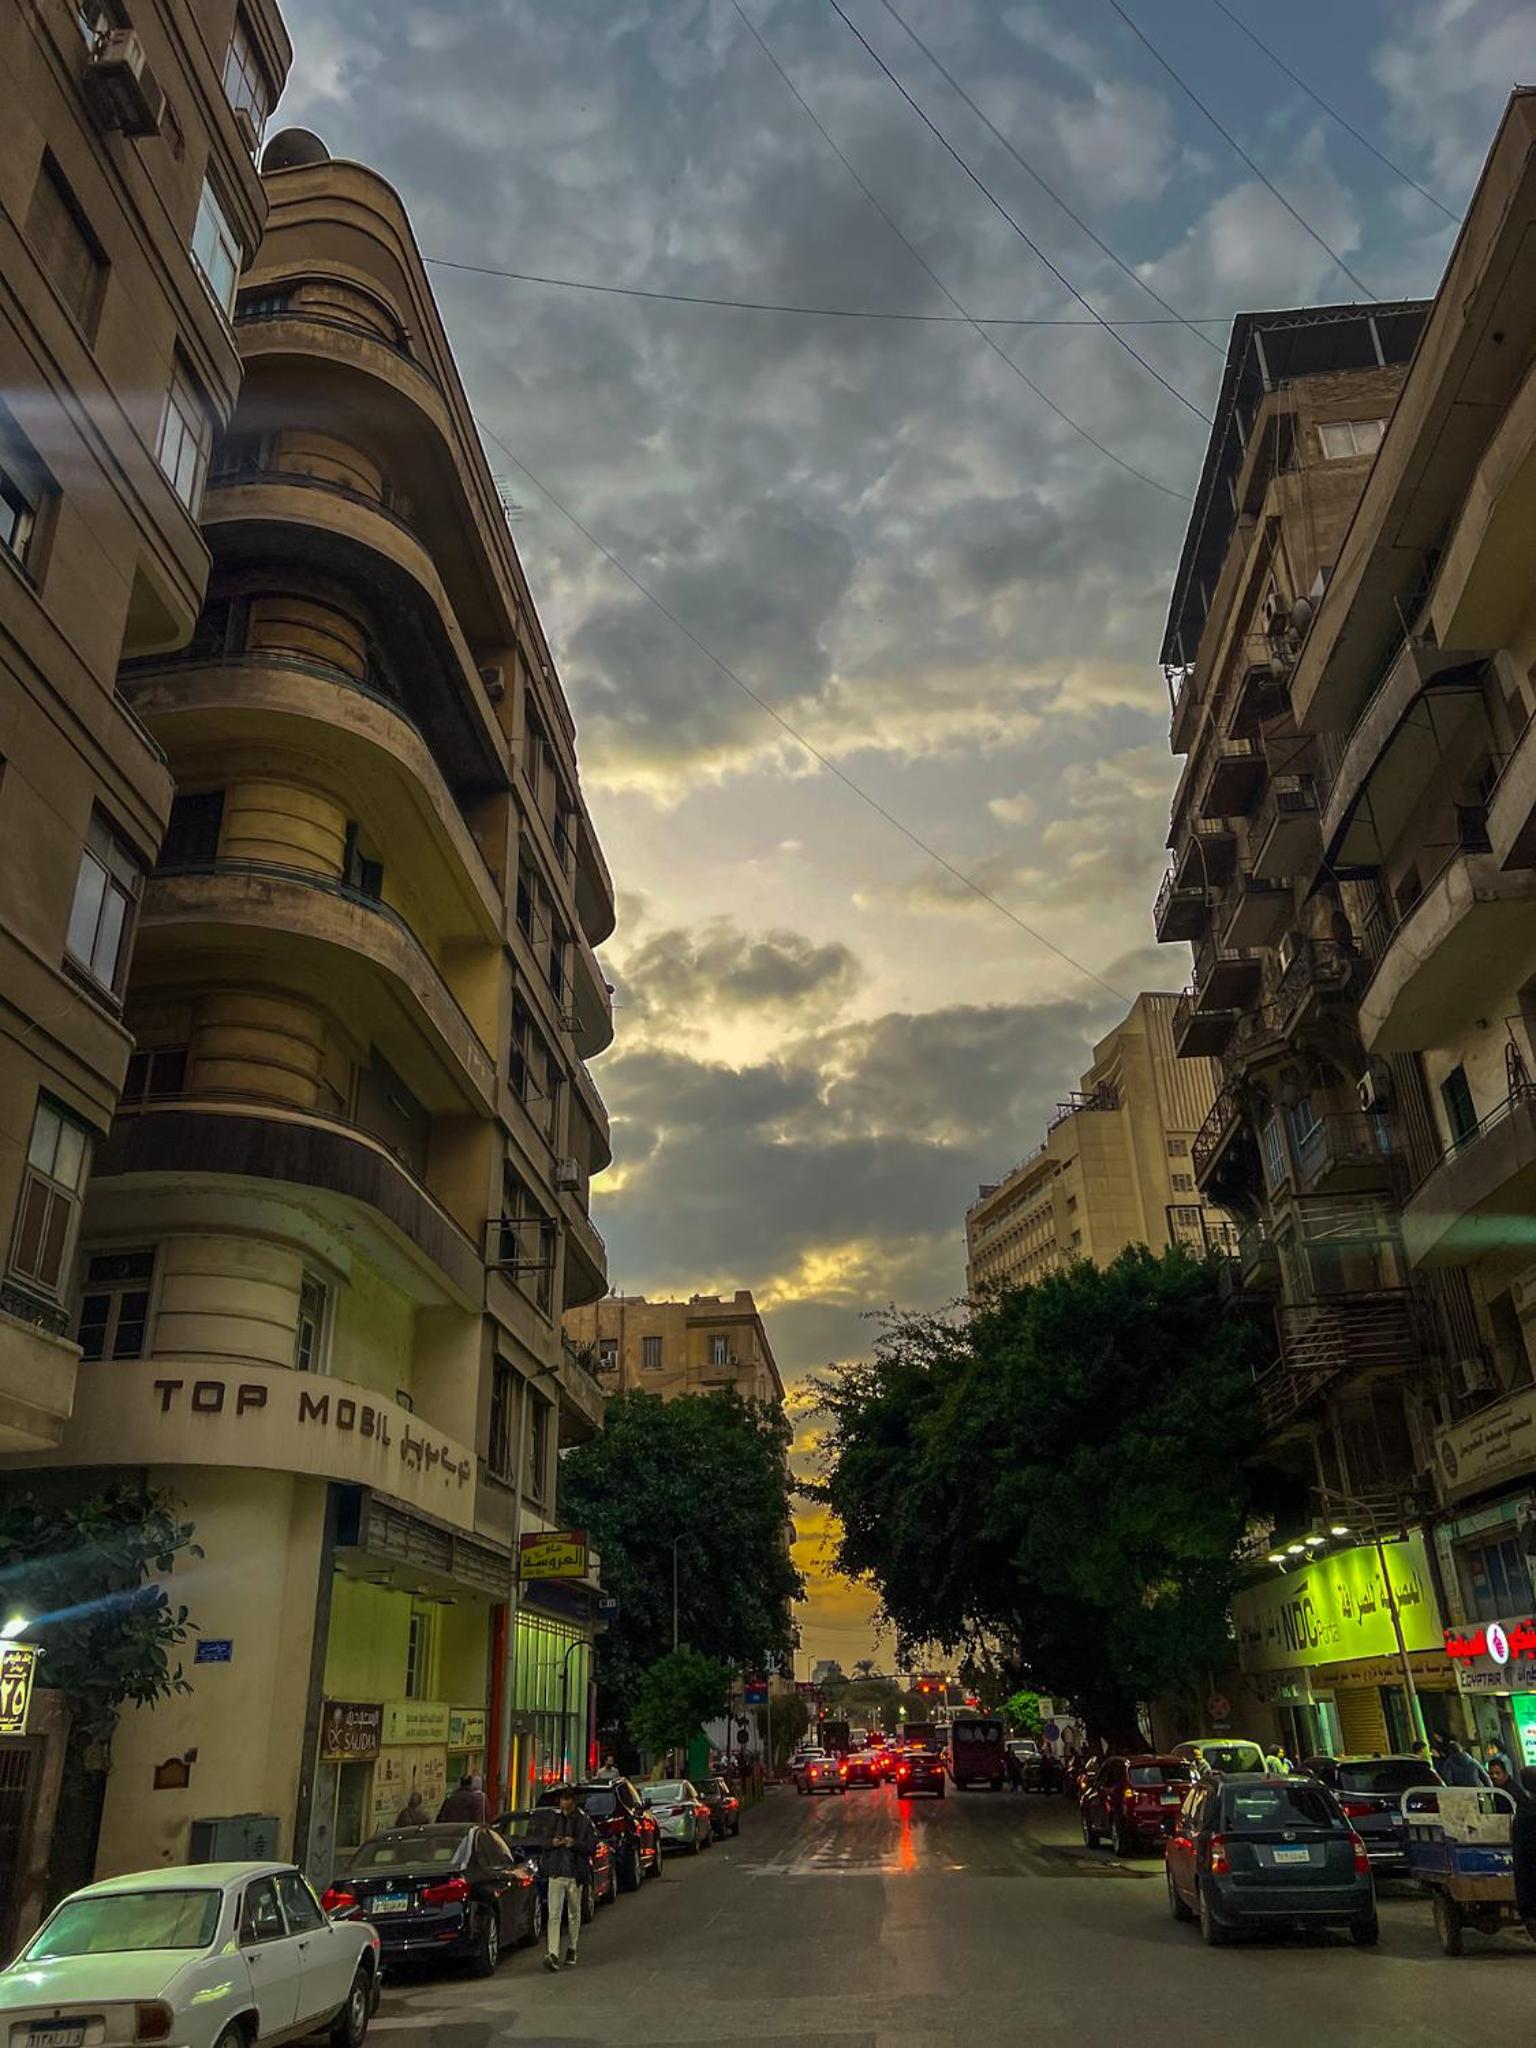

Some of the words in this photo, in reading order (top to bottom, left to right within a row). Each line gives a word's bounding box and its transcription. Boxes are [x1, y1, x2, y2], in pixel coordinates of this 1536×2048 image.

[154, 1379, 268, 1415] TOP
[298, 1391, 392, 1447] MOBIL
[1280, 1597, 1319, 1651] NDC
[1461, 1670, 1502, 1688] EGYPTAIR
[343, 1731, 377, 1751] SAUDIA
